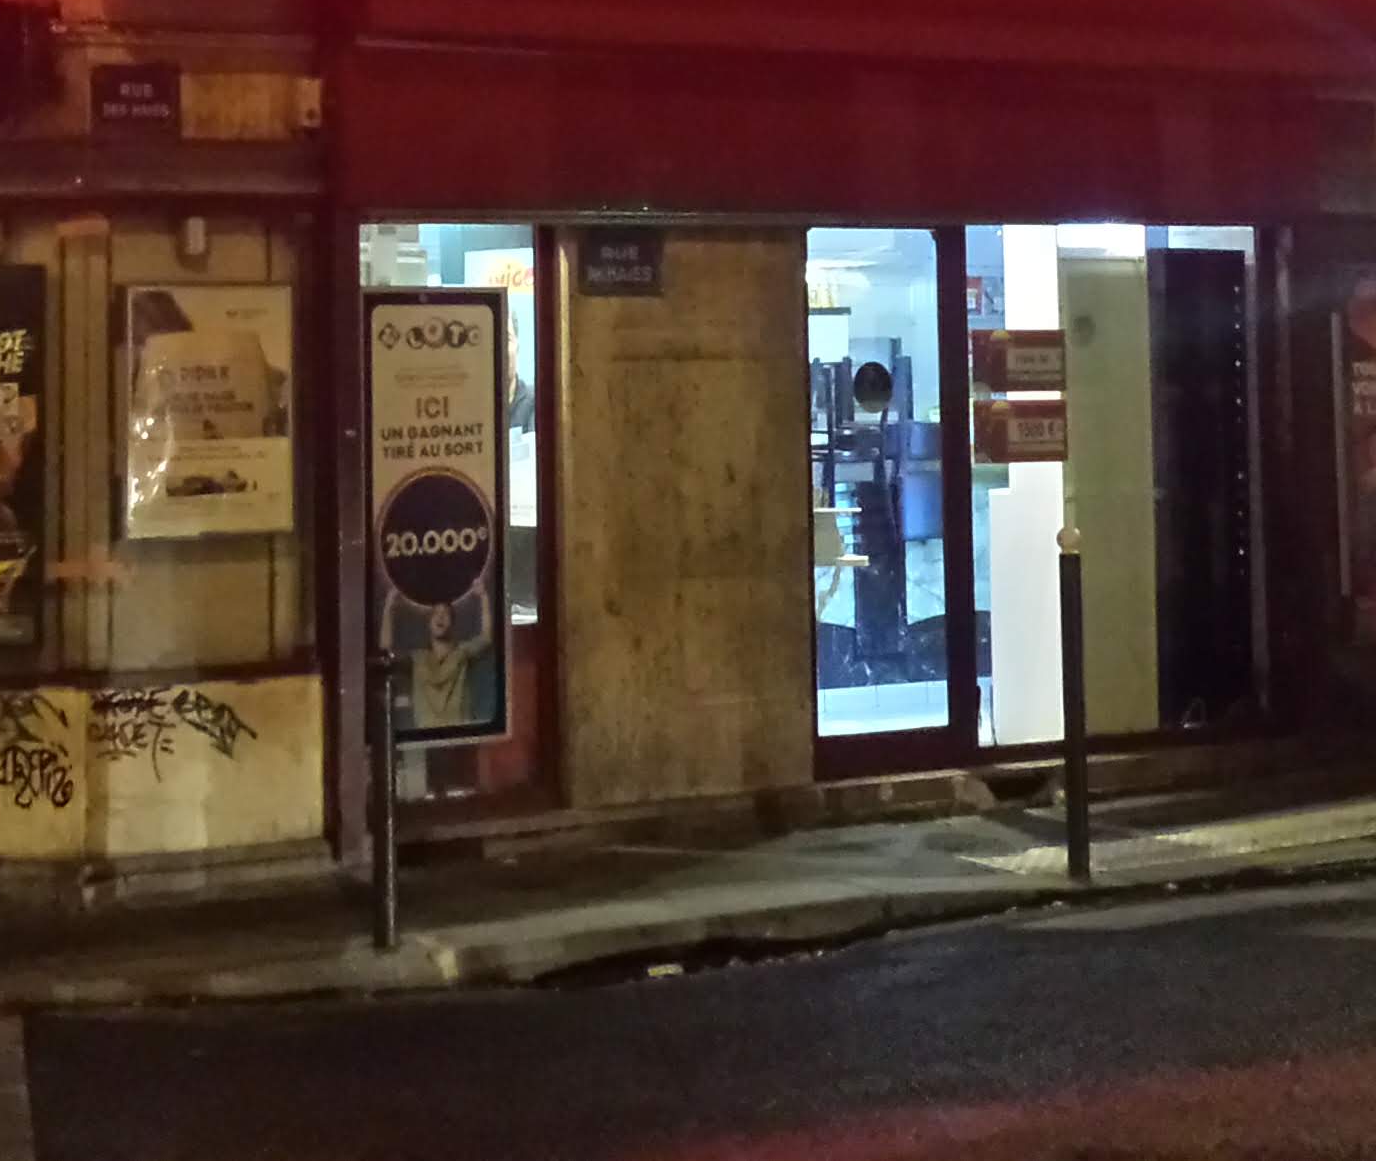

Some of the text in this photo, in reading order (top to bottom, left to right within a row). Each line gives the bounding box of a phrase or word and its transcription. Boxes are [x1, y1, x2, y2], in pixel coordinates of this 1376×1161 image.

[120, 82, 154, 98] RUE
[416, 396, 449, 419] ICI
[381, 423, 484, 441] UN GAGNANT
[383, 441, 484, 459] TIRÉ AU SORT
